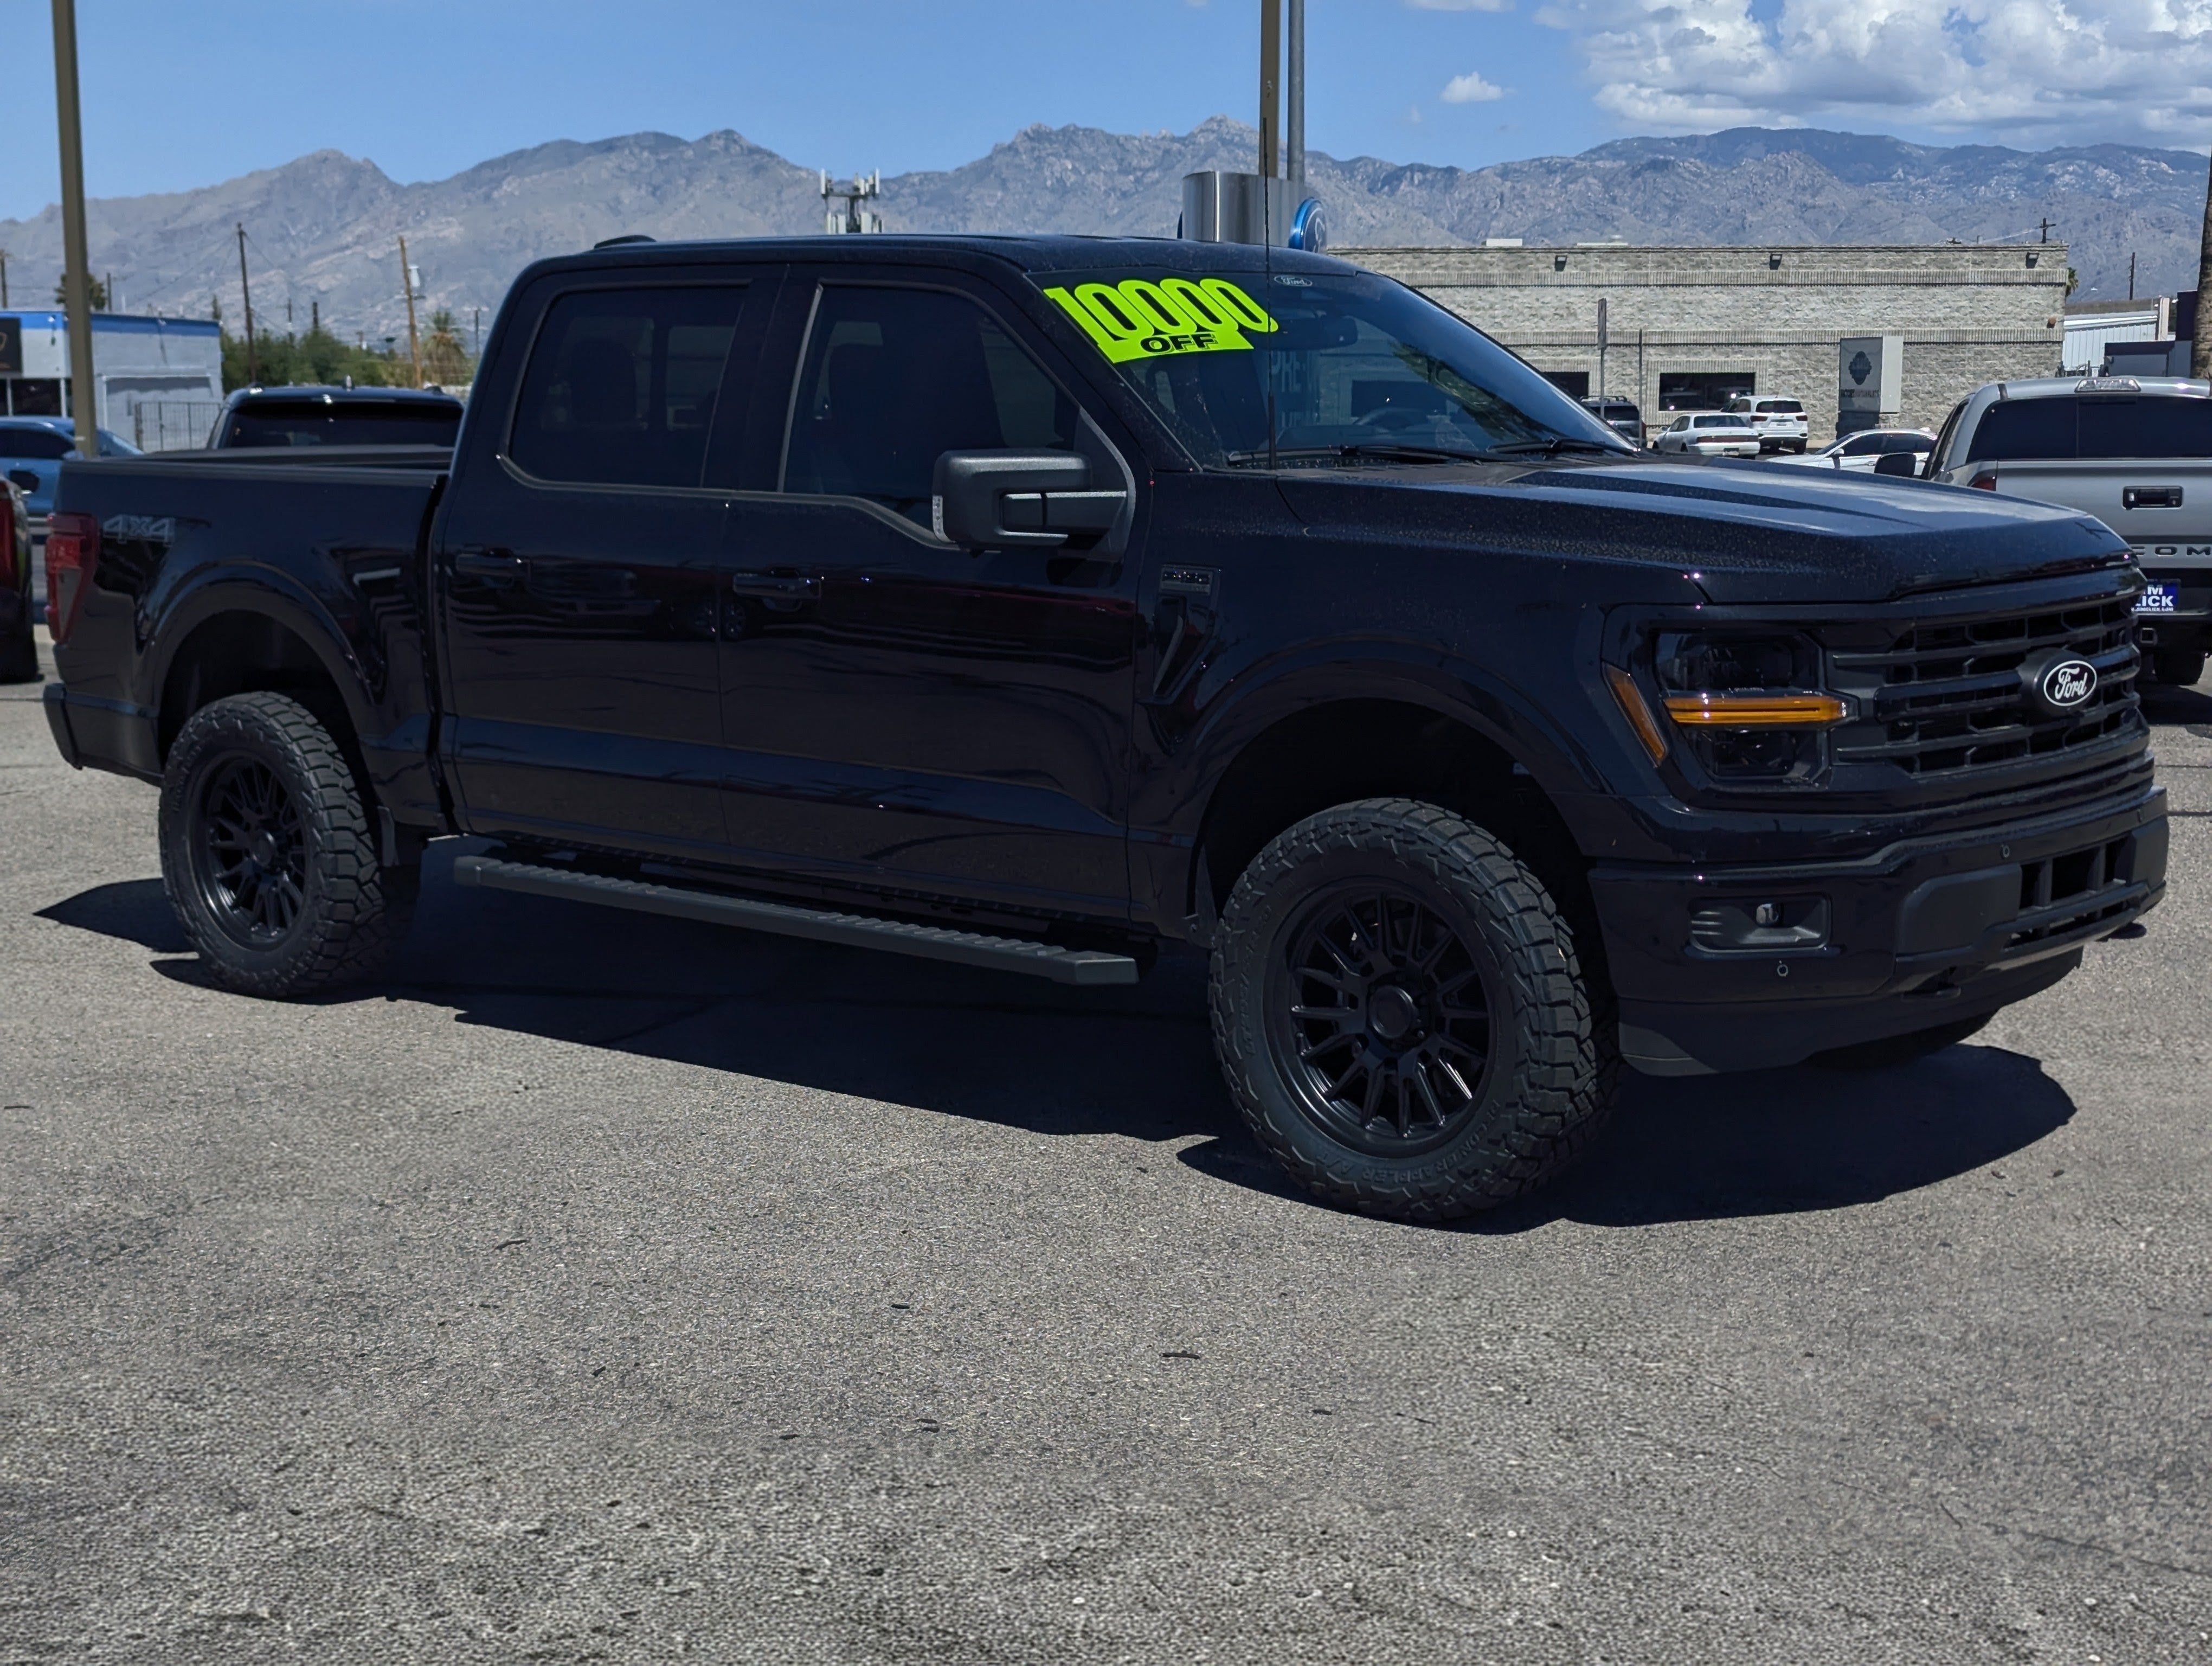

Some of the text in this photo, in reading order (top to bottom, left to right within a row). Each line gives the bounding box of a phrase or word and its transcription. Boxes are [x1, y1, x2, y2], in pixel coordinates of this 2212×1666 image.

[1043, 278, 1279, 343] 10000
[1140, 332, 1219, 355] OFF
[2054, 667, 2088, 700] Ford
